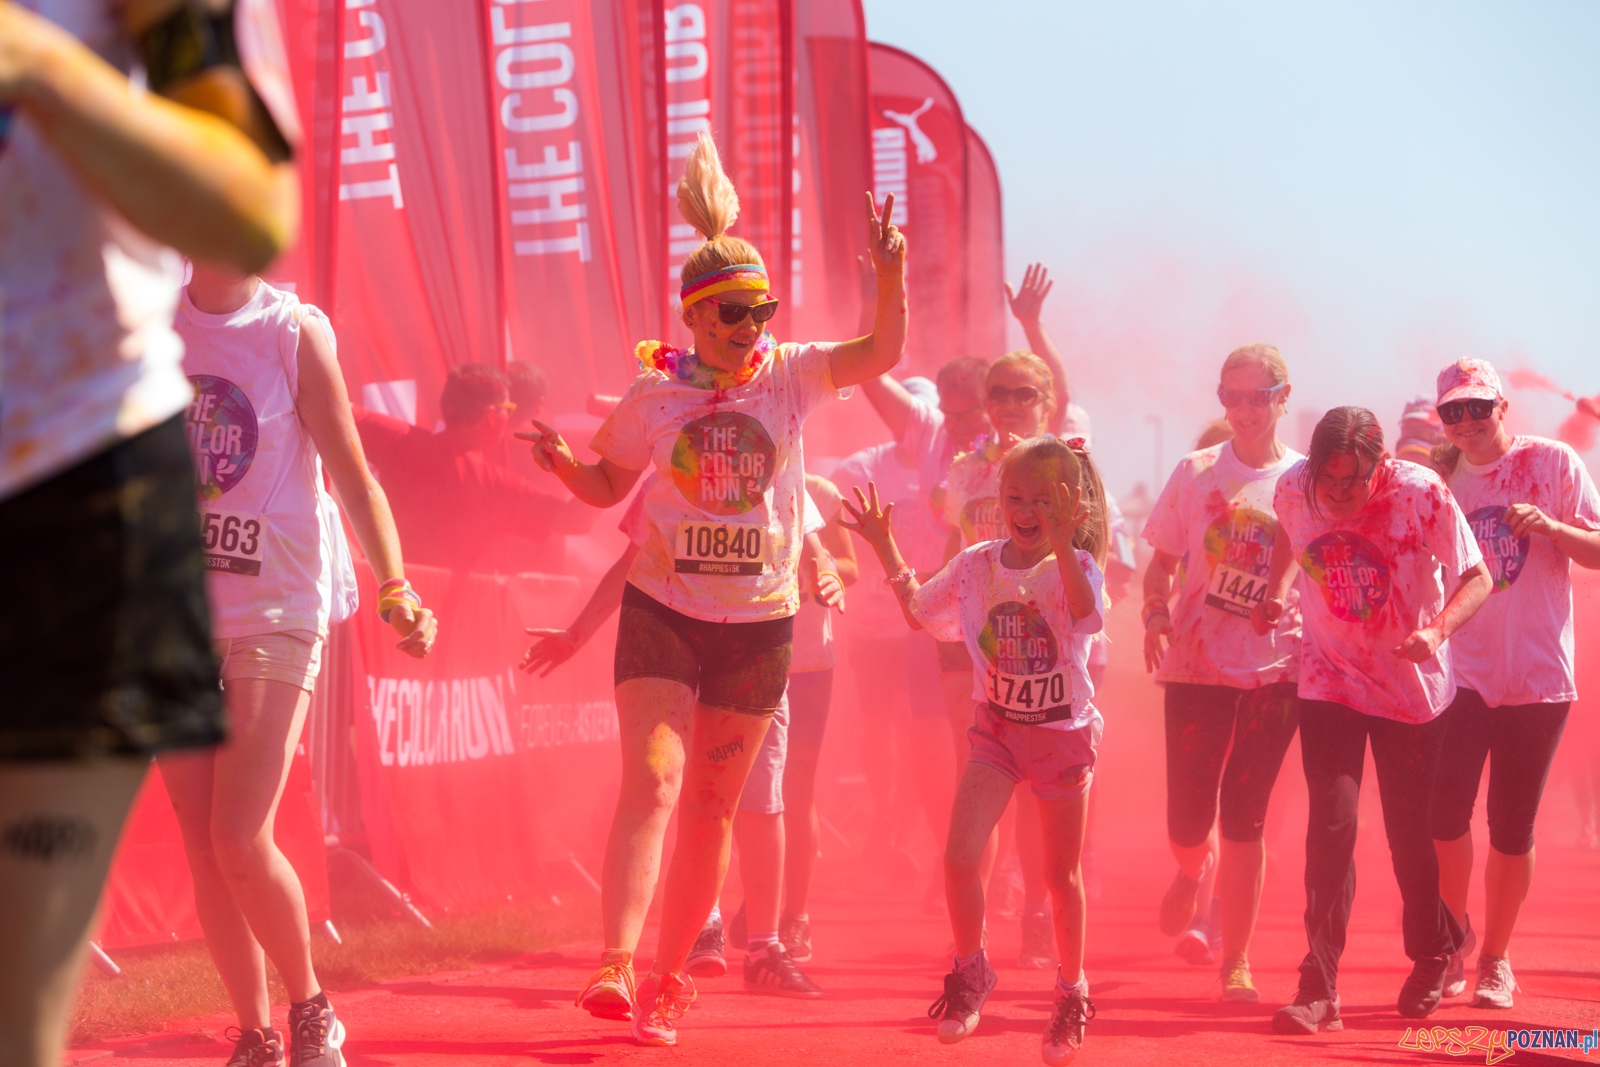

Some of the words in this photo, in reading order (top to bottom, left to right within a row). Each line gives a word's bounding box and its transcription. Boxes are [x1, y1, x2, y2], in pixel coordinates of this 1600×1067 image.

[701, 426, 738, 451] THE
[701, 452, 766, 477] COLOR
[701, 478, 740, 502] RUN
[1470, 517, 1497, 539] THE
[684, 525, 761, 559] 10840
[1478, 535, 1520, 560] OLOR
[1325, 566, 1380, 588] COLOR
[995, 615, 1025, 637] THE
[996, 637, 1049, 660] COLOR
[991, 672, 1065, 709] 17470
[706, 739, 744, 764] HAPPY
